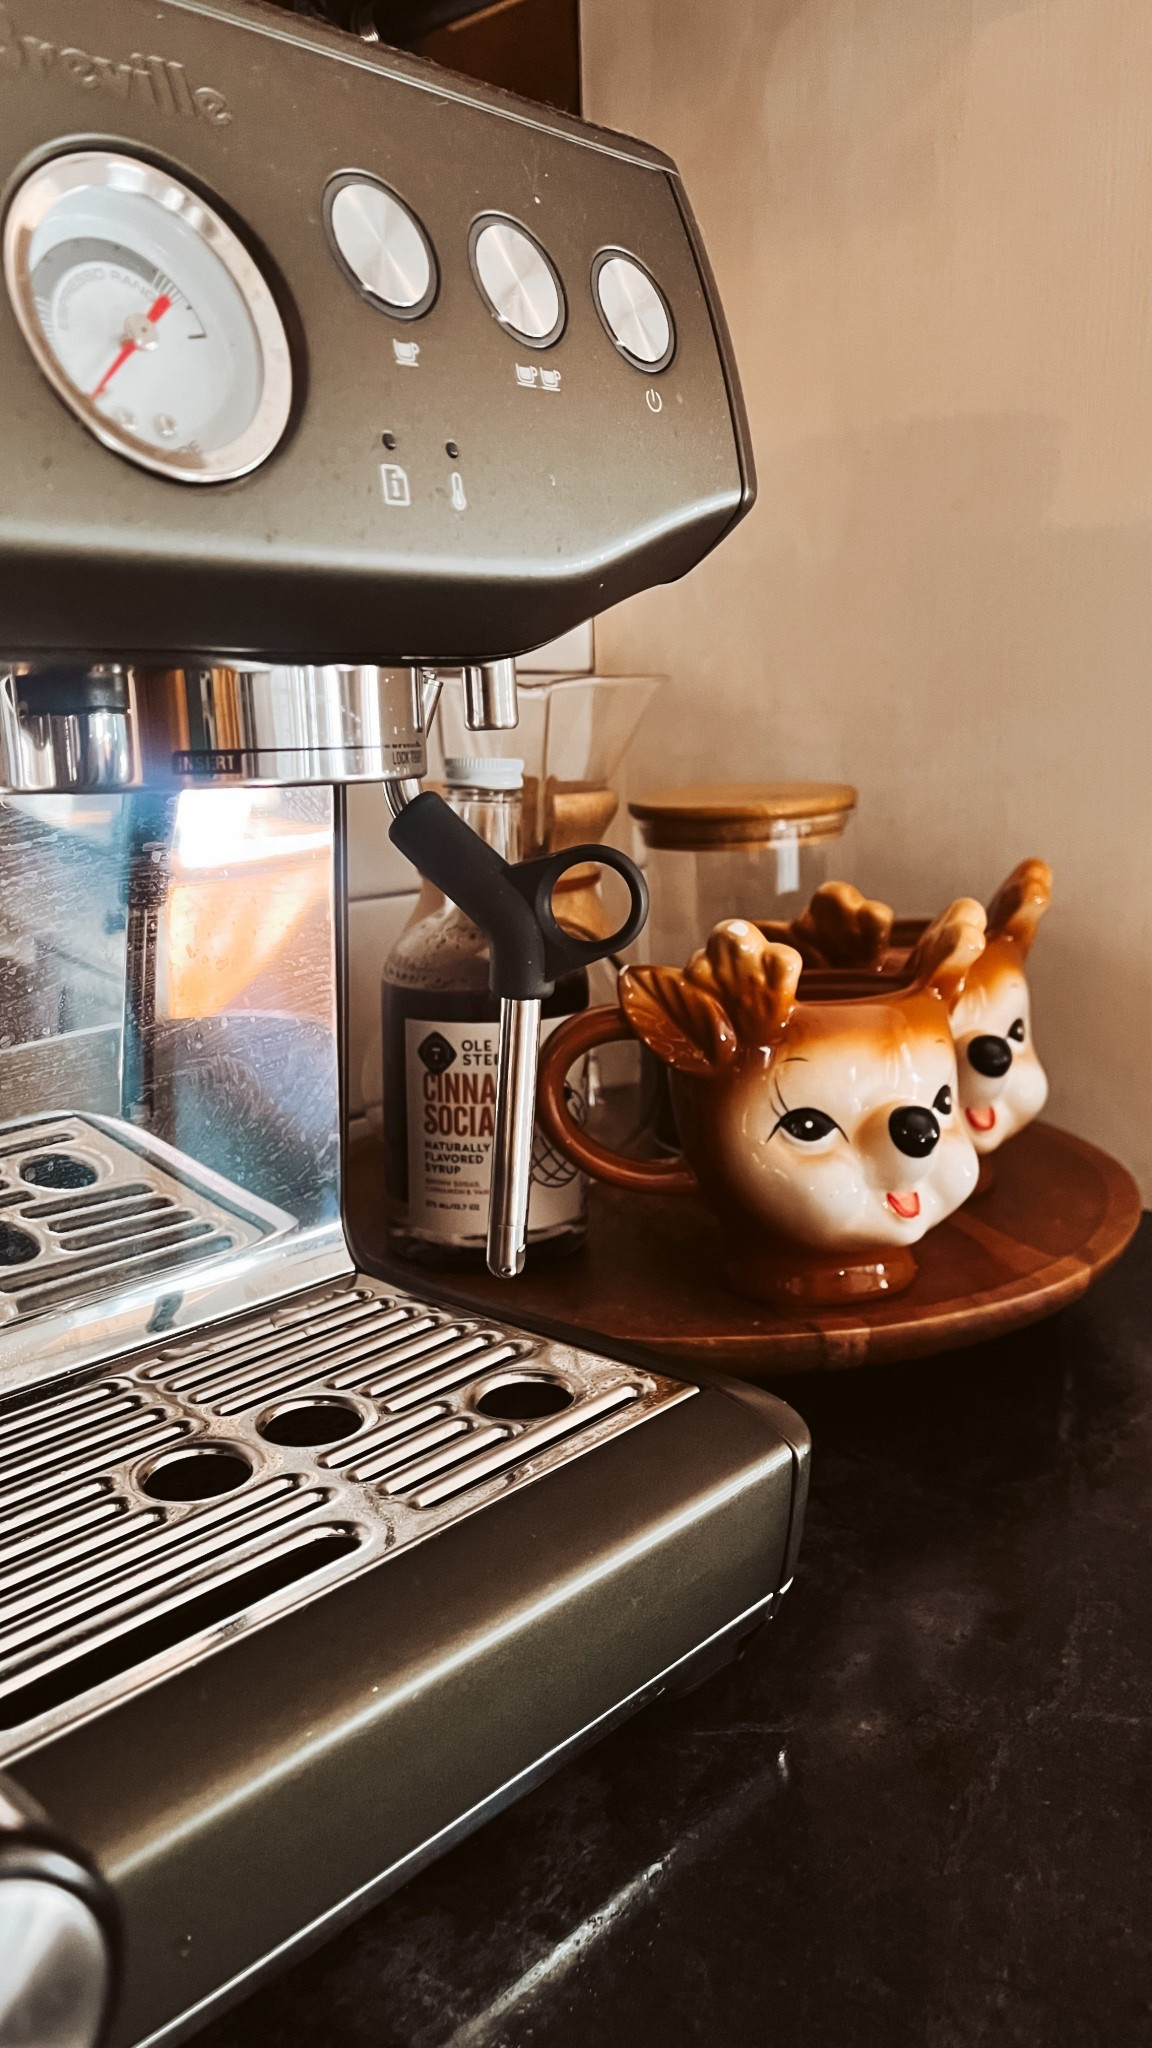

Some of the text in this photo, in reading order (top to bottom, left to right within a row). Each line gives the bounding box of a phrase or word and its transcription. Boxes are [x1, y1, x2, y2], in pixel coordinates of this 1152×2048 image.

[178, 754, 234, 771] INSERT
[392, 751, 410, 765] LOCK
[461, 1039, 492, 1052] OLE
[425, 1140, 491, 1153] NATURALLY
[425, 1152, 484, 1165] FLAVORED
[425, 1162, 461, 1175] SYRUP
